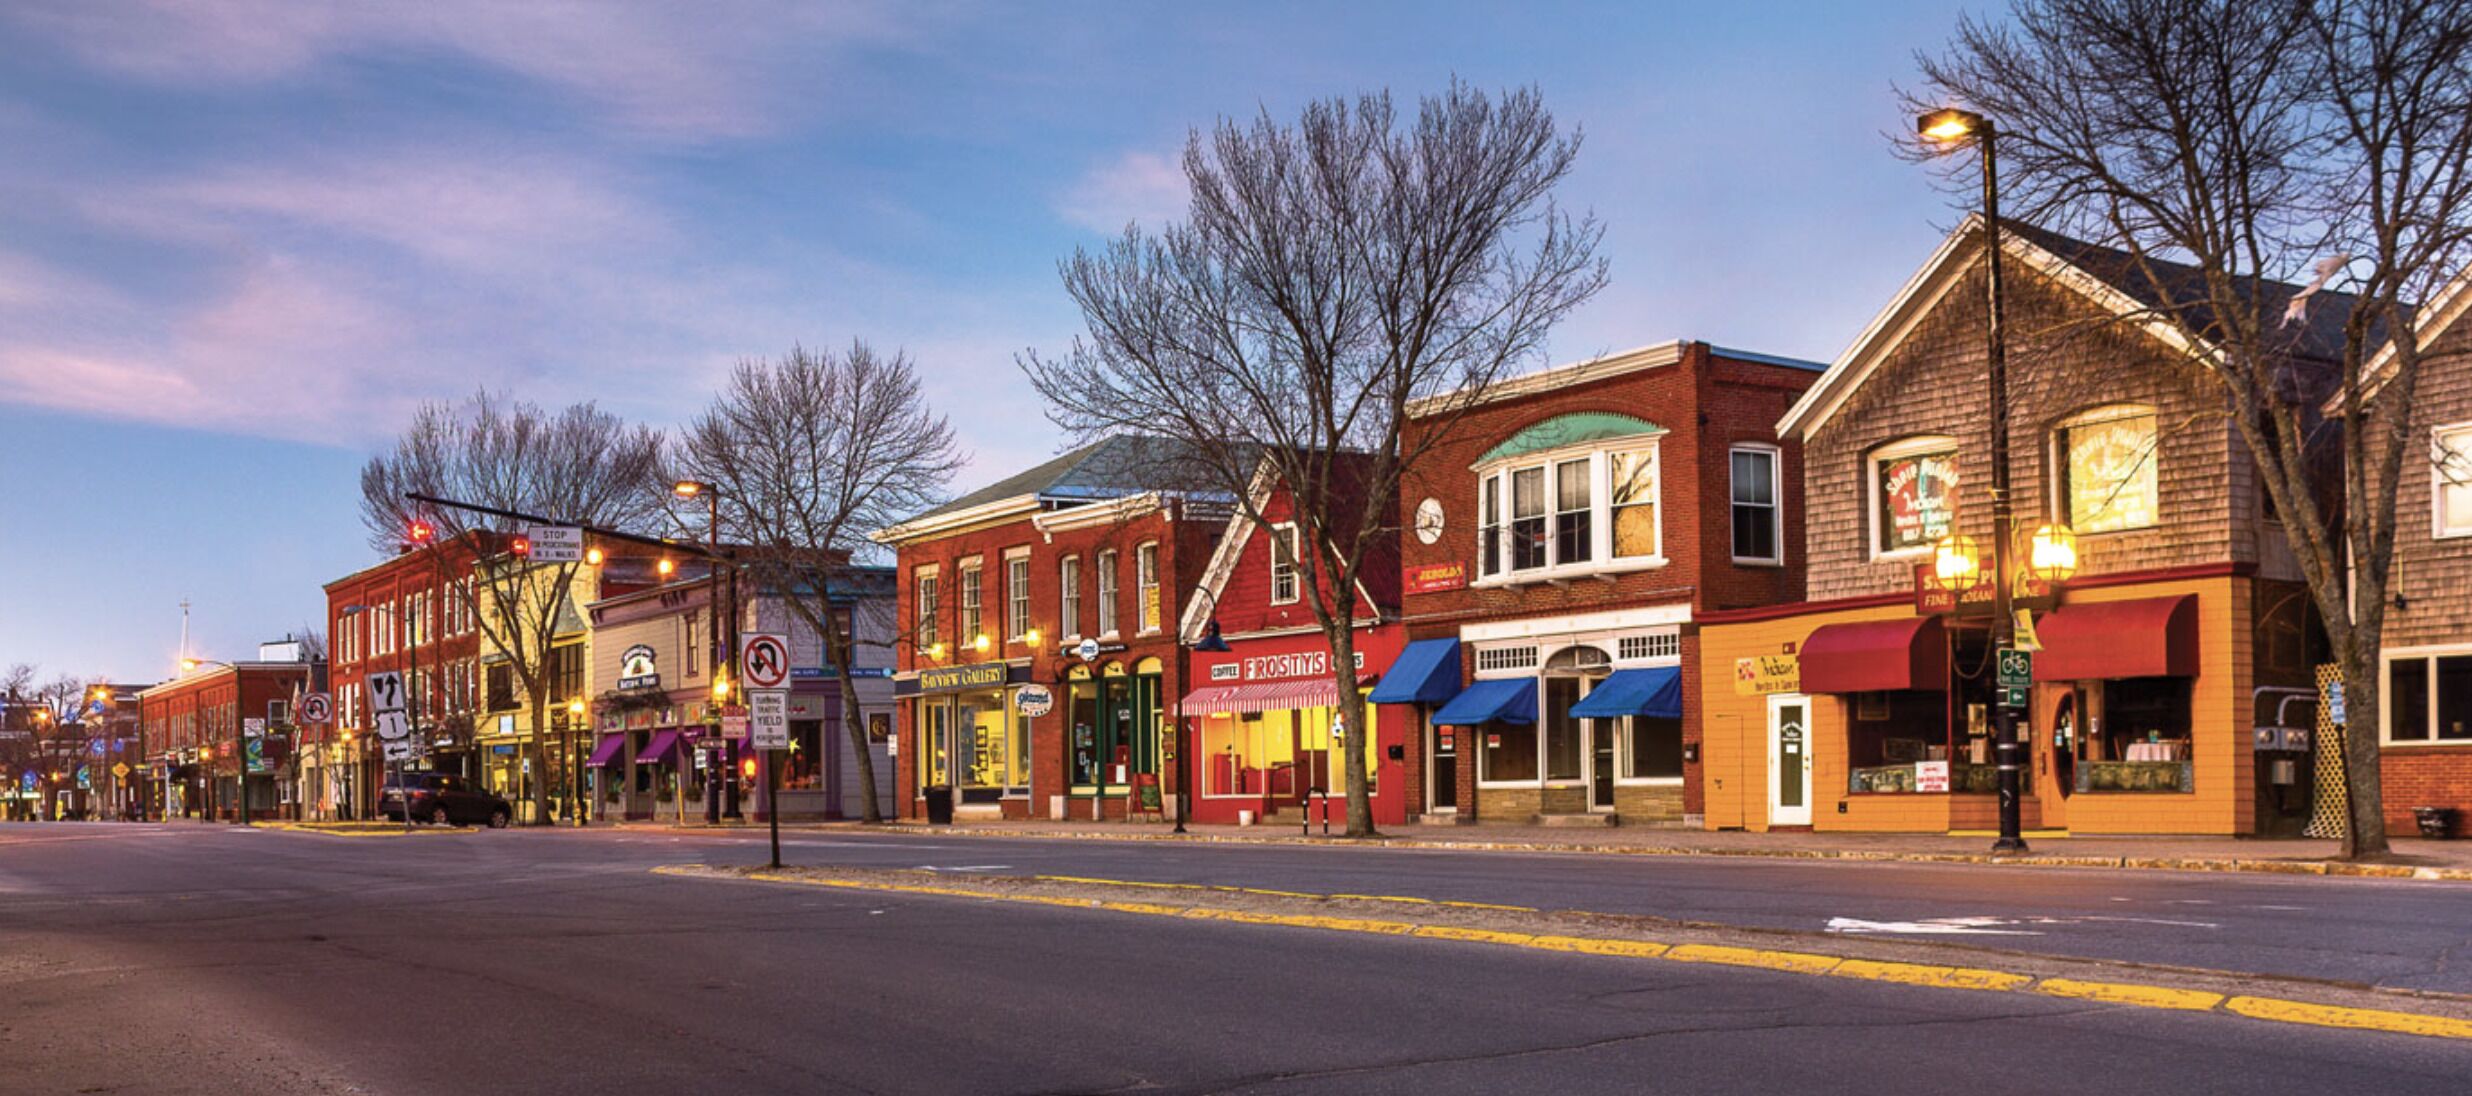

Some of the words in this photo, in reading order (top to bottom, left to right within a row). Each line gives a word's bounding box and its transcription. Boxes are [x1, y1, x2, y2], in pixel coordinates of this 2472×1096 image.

[543, 530, 568, 539] STOP
[1212, 665, 1238, 678] COFFEE
[1245, 653, 1324, 680] FROSTYS
[921, 672, 960, 689] BAYVIEW
[961, 665, 1001, 685] GALLERY
[757, 705, 781, 714] TRAFFIC
[390, 716, 397, 733] 1
[757, 716, 782, 726] YIELD
